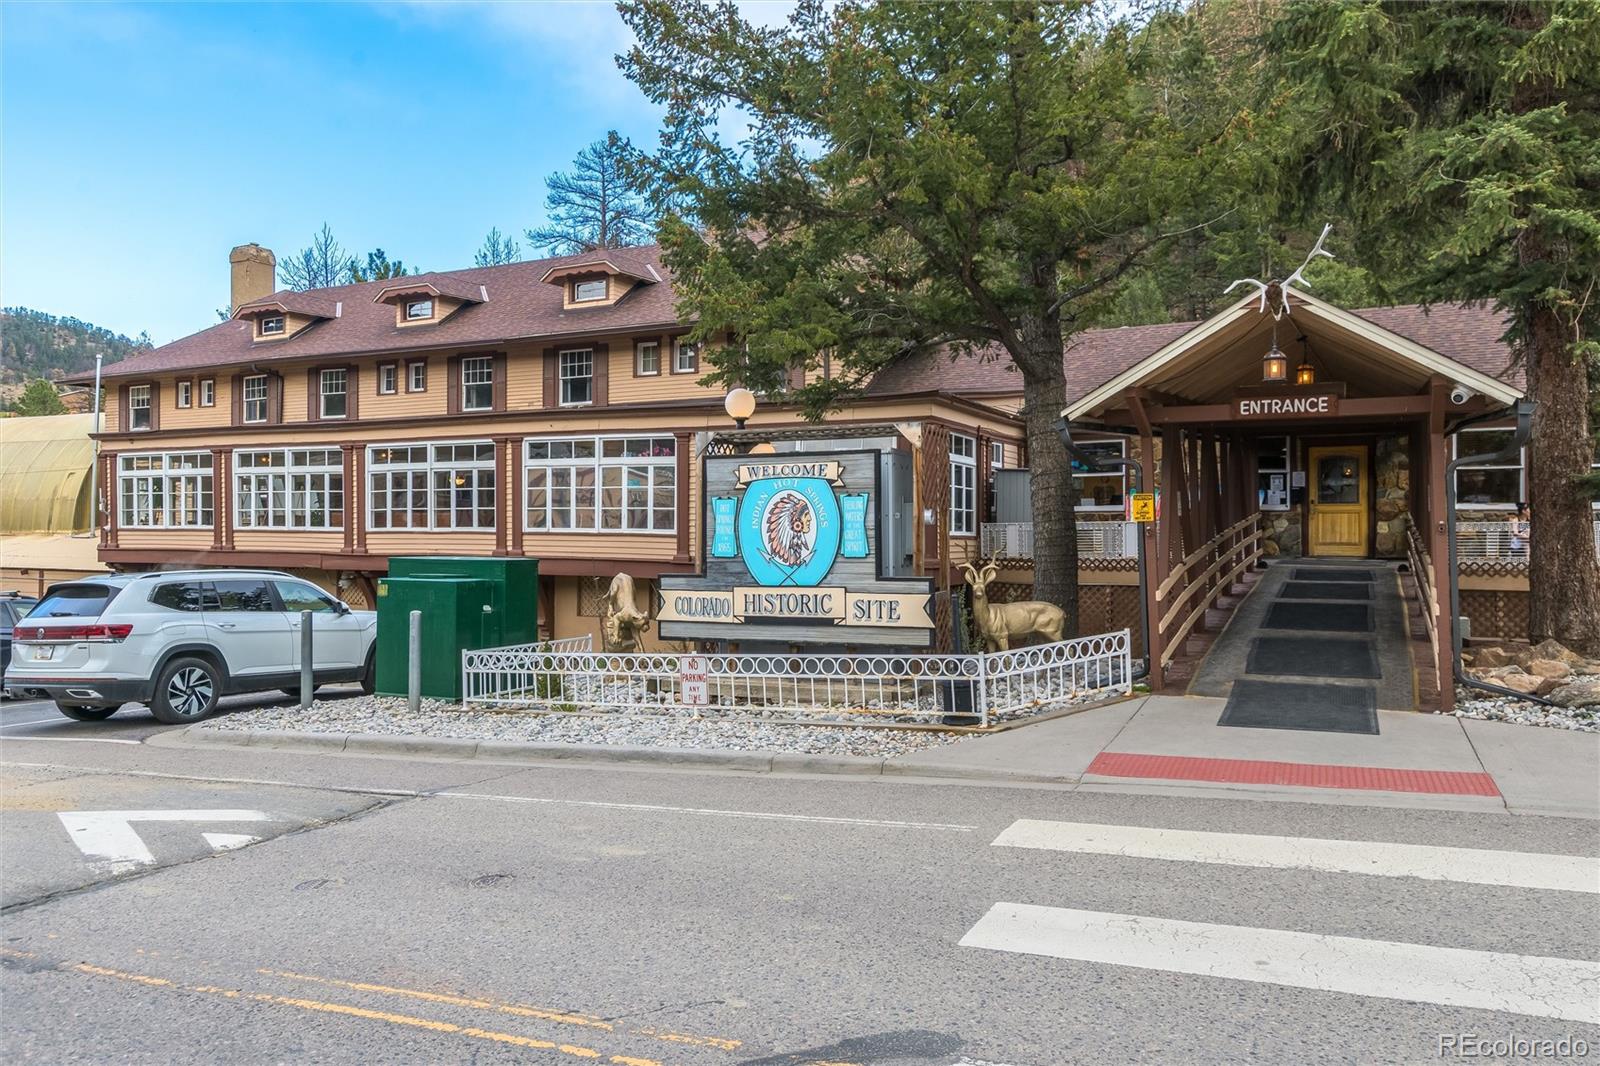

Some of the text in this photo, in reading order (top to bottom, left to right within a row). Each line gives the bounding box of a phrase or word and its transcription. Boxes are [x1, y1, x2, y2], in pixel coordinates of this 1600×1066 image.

[1240, 397, 1329, 415] ENTRANCE
[746, 463, 829, 478] WELCOME
[751, 479, 829, 529] INDIAN HOT SPRINGS
[674, 593, 901, 623] COLORADO HISTORIC SITE
[688, 661, 699, 671] NO
[682, 673, 706, 683] PARKING
